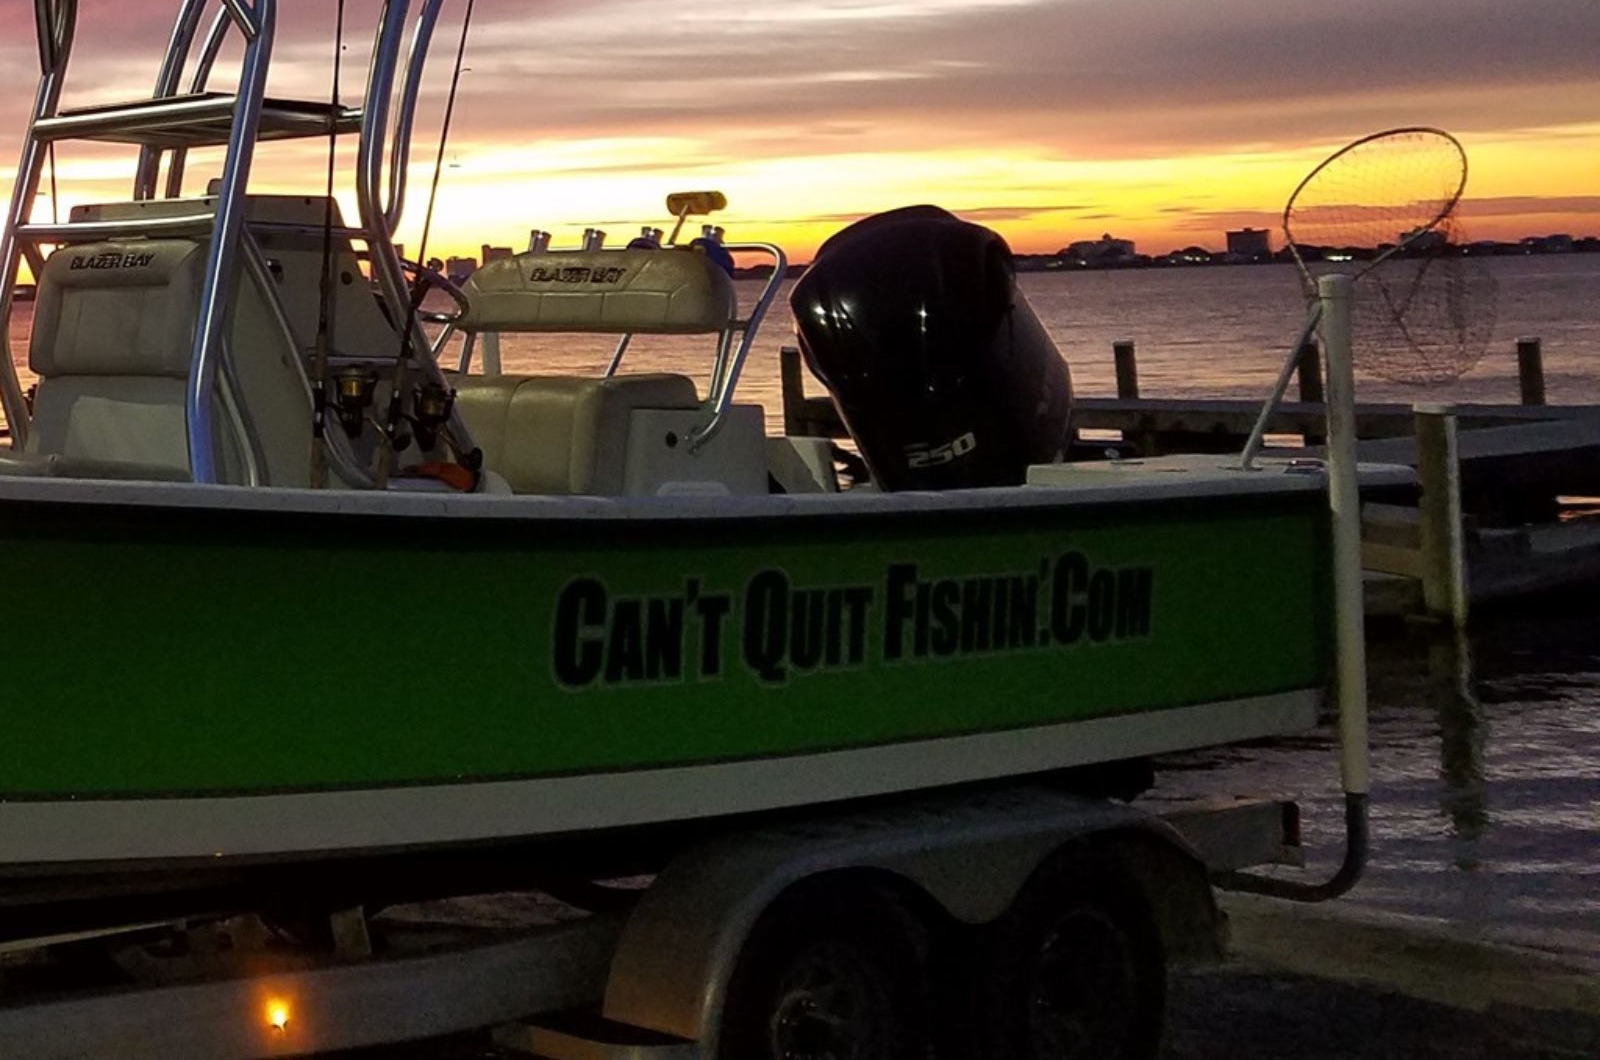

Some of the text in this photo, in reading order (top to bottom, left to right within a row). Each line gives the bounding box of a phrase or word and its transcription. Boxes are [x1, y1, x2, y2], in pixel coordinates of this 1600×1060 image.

[71, 253, 154, 270] BLAZER BAY
[905, 431, 977, 469] 250
[742, 567, 875, 683] QUIT
